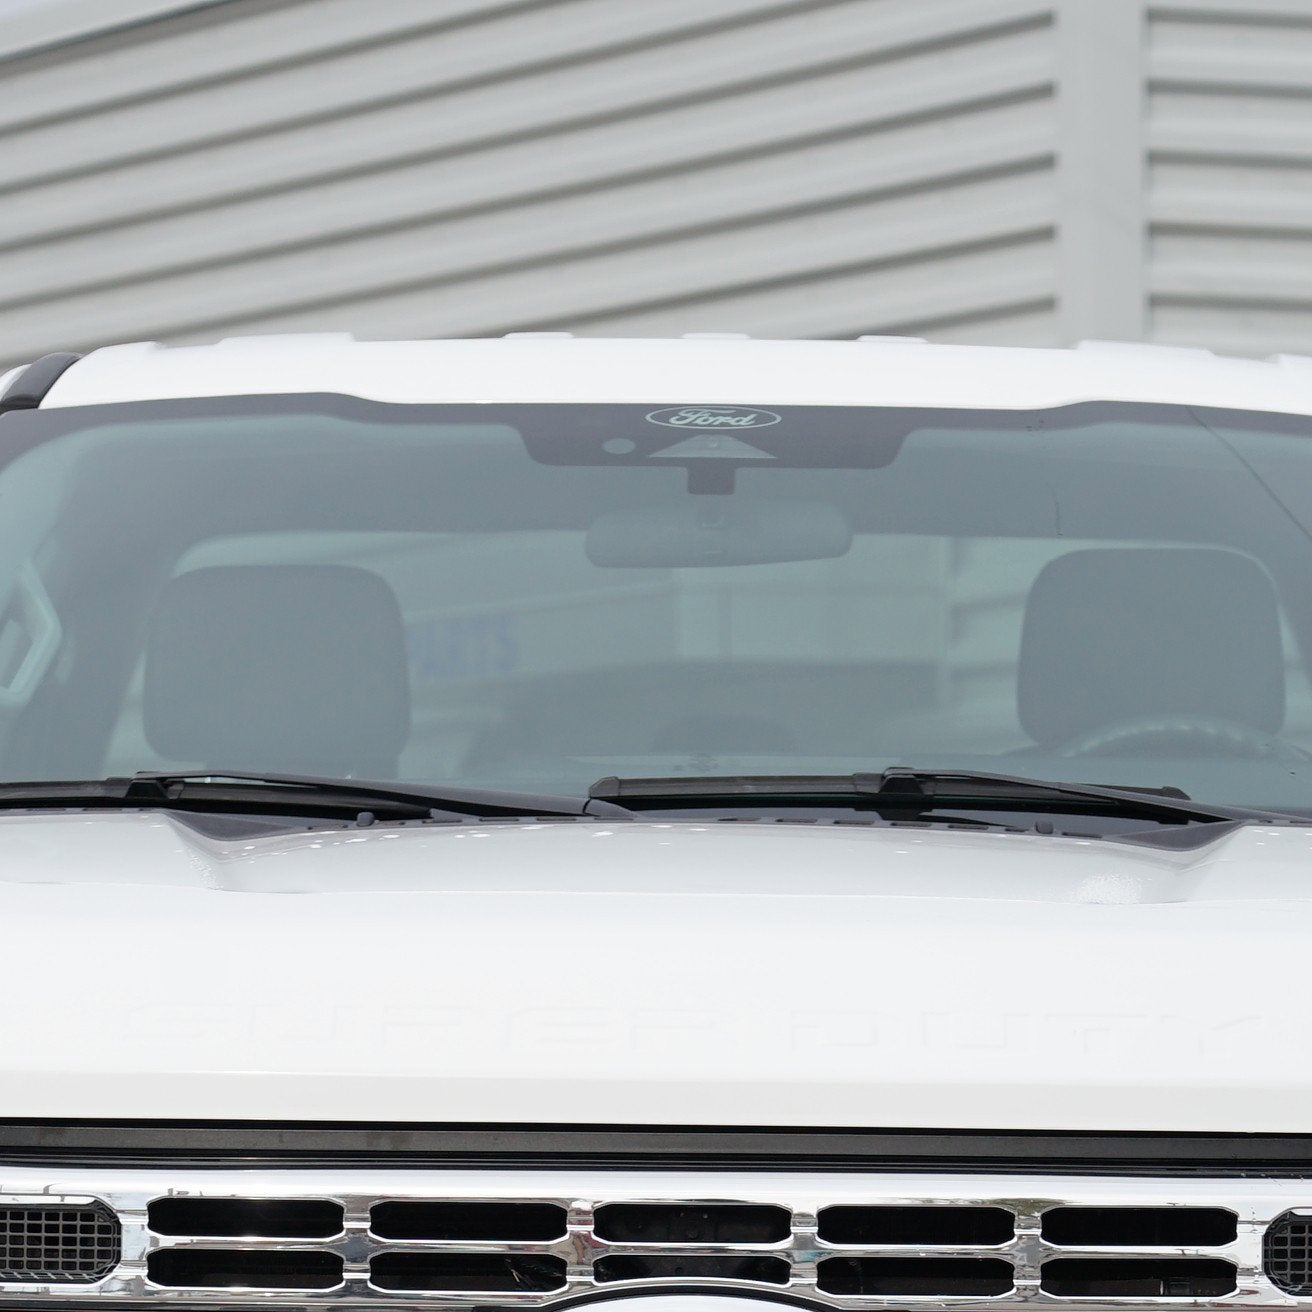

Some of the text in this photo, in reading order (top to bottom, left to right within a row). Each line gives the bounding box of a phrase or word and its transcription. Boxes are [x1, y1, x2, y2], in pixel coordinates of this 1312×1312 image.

[669, 408, 758, 426] Ford
[122, 1000, 1266, 1060] SUPER DUTY
